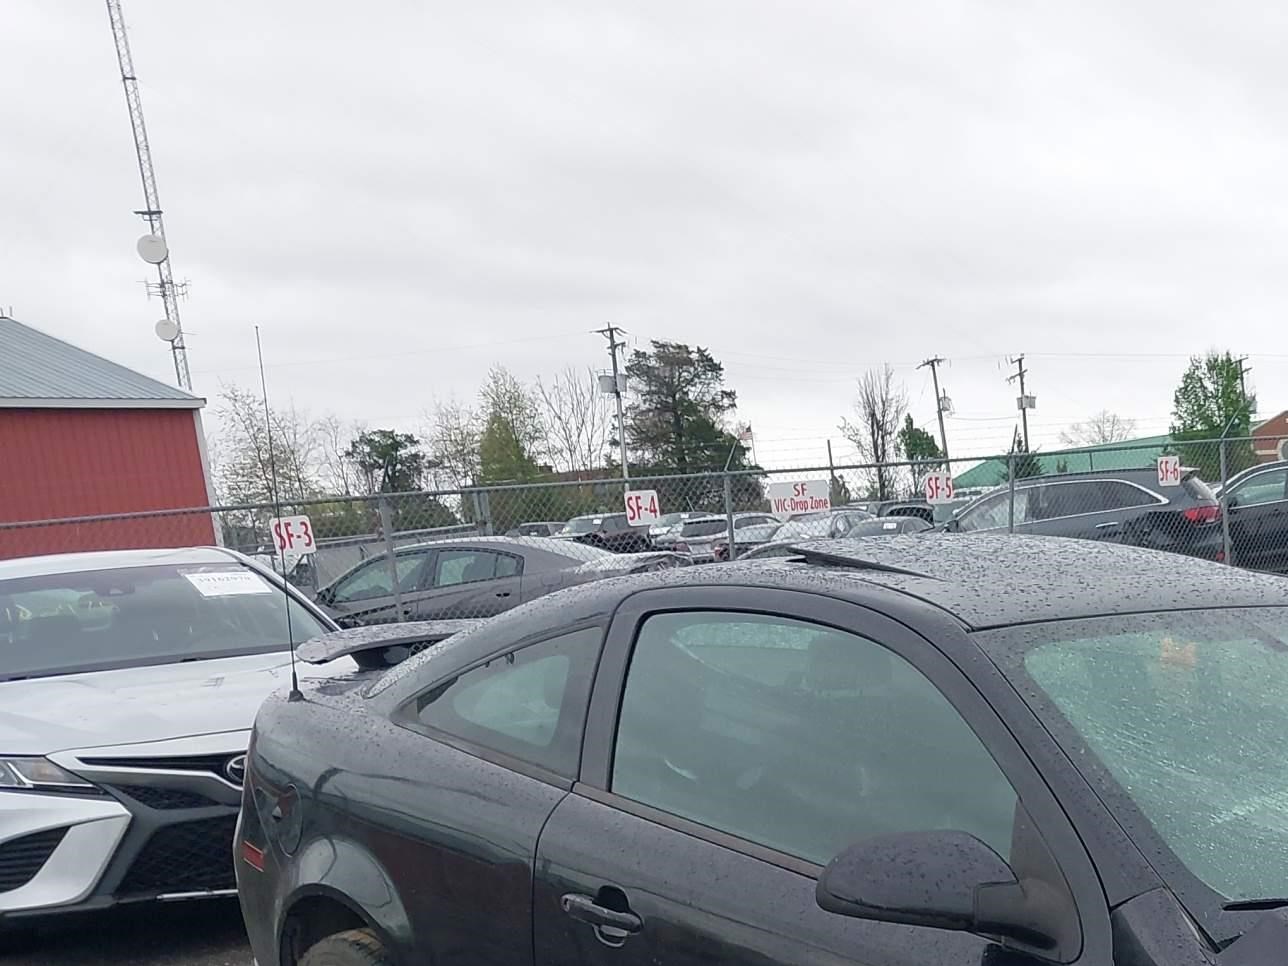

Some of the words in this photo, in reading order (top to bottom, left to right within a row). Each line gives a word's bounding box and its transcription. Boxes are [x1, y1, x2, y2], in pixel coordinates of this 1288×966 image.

[1159, 460, 1178, 481] SF-6
[793, 482, 808, 497] SF
[928, 476, 952, 500] SF-5
[627, 495, 658, 521] SF-4
[809, 496, 829, 510] Zone
[274, 521, 312, 550] SF-3
